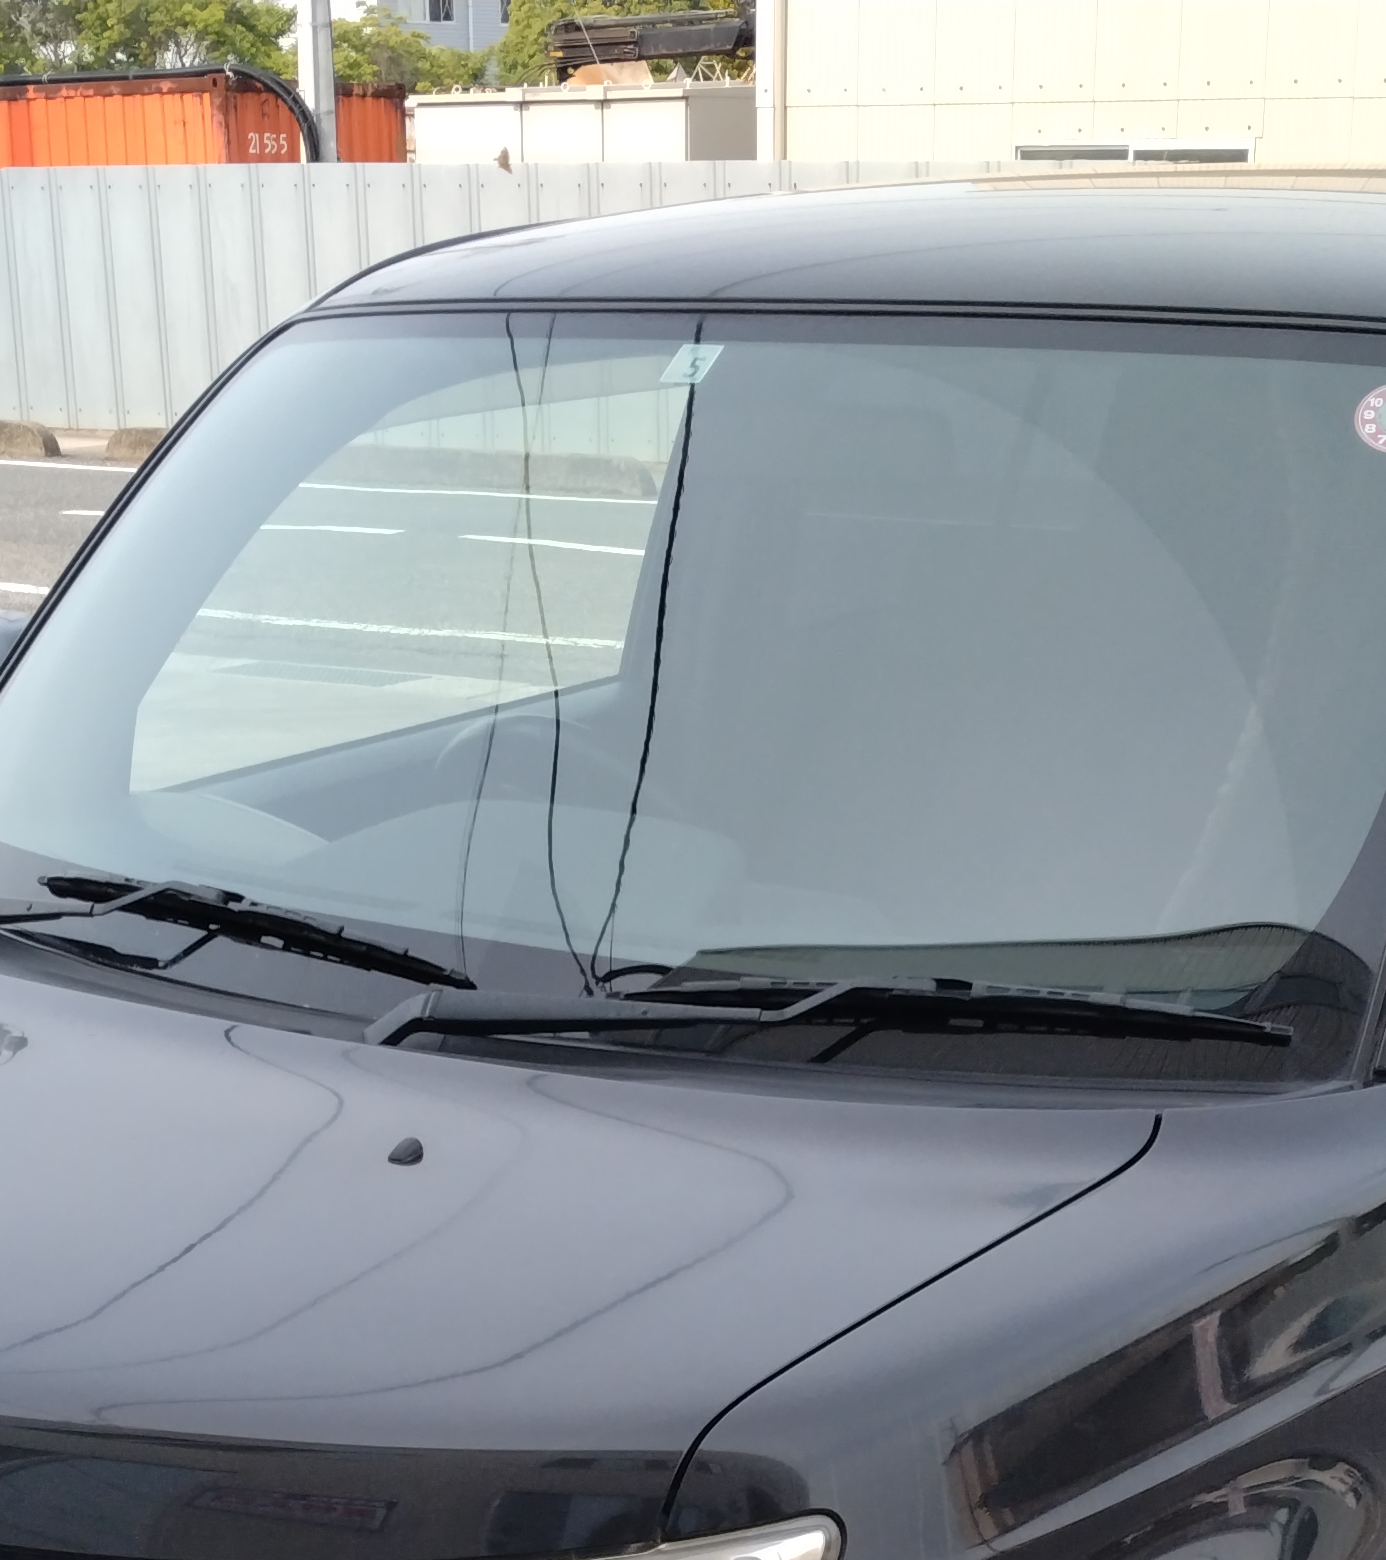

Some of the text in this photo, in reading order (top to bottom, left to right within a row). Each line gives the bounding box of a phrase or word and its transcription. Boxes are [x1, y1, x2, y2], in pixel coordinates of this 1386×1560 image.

[682, 356, 707, 377] 5
[1369, 397, 1384, 408] 10
[1363, 409, 1375, 420] 9
[1364, 423, 1377, 434] 8
